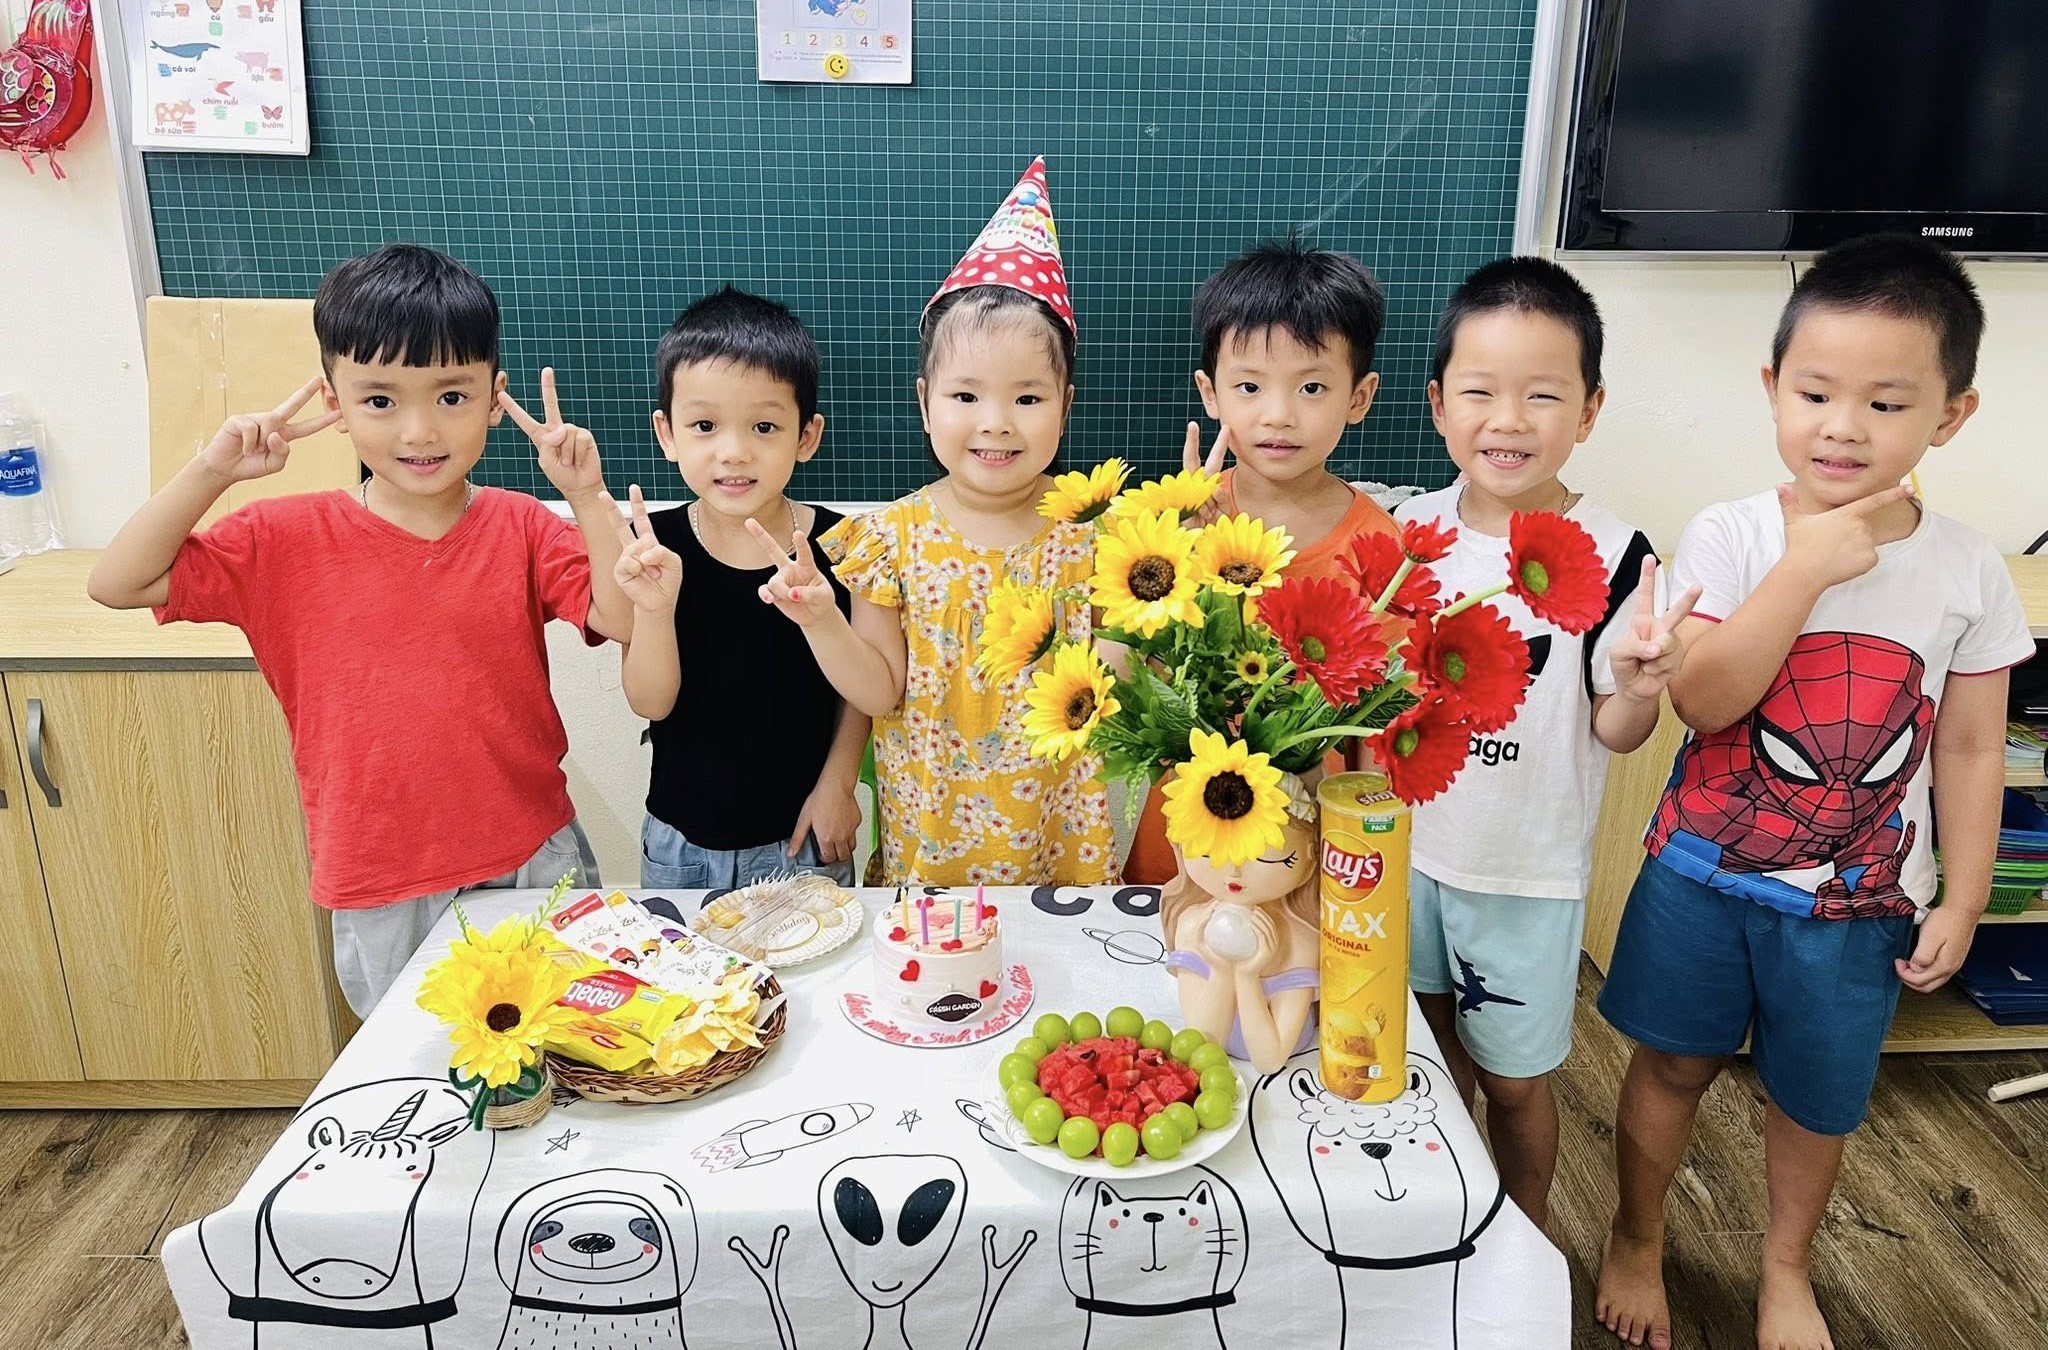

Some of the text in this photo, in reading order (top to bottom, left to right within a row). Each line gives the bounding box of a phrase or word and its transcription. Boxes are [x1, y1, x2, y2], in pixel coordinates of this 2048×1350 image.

[784, 34, 894, 48] 1 2 3 4 5
[172, 64, 182, 72] cá
[202, 97, 222, 105] chim
[1922, 227, 1974, 237] SAMSUNG
[0, 465, 38, 480] AQUAFINA
[1322, 841, 1380, 888] Lay's
[1322, 928, 1371, 952] ORIGINAL
[929, 1002, 980, 1014] FRESH GARDEN
